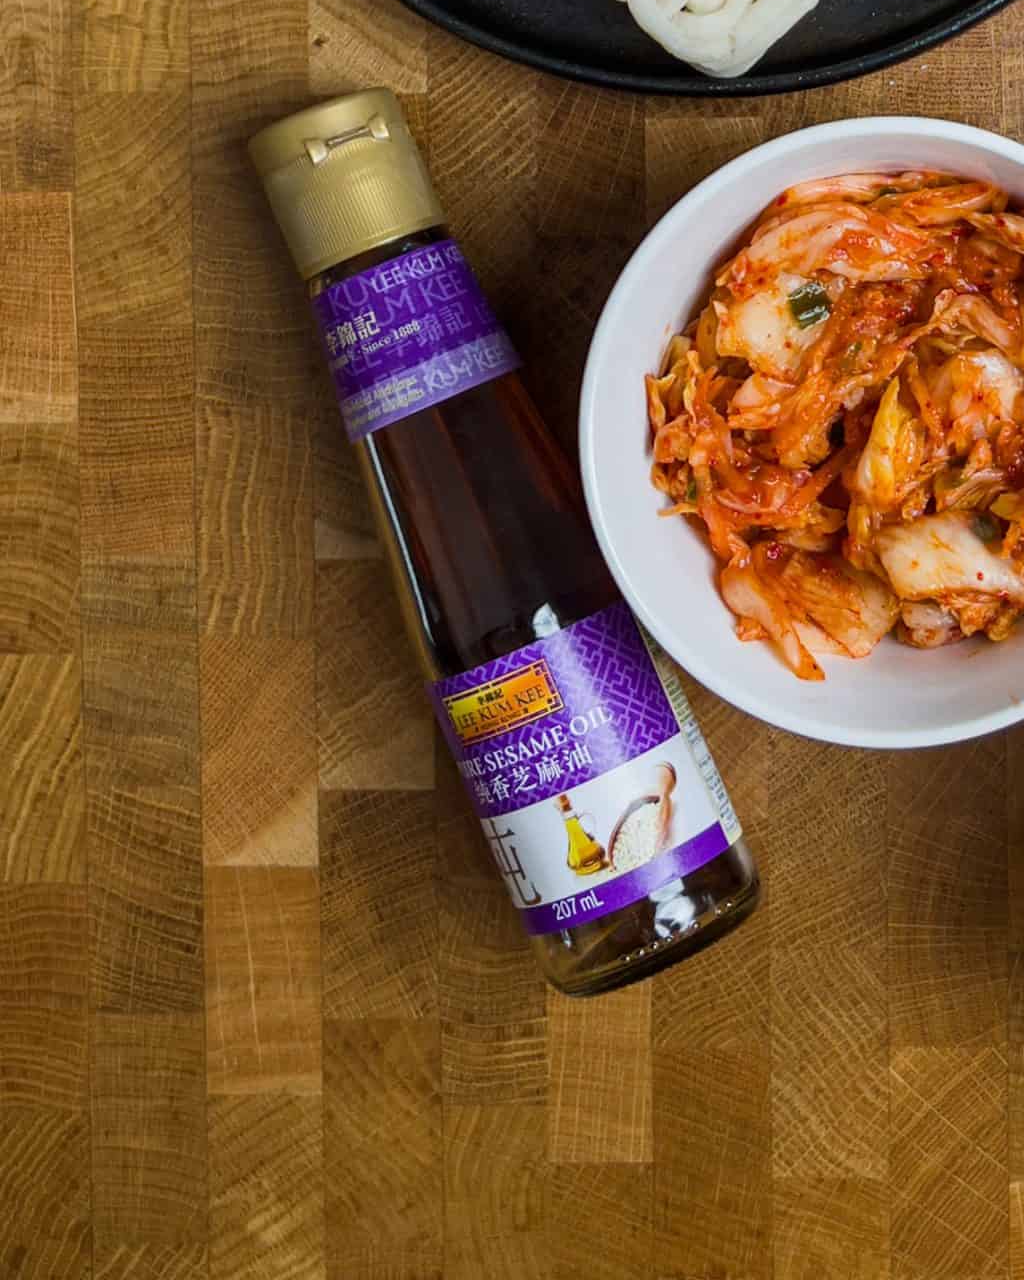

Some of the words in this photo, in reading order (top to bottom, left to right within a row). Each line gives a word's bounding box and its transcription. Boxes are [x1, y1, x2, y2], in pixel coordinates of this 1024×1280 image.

[371, 266, 405, 293] LEE
[405, 251, 443, 279] KUM
[515, 685, 546, 707] KEE
[484, 727, 566, 770] SESAME
[568, 707, 613, 736] OIL
[552, 898, 578, 920] 207
[581, 890, 604, 911] mL
